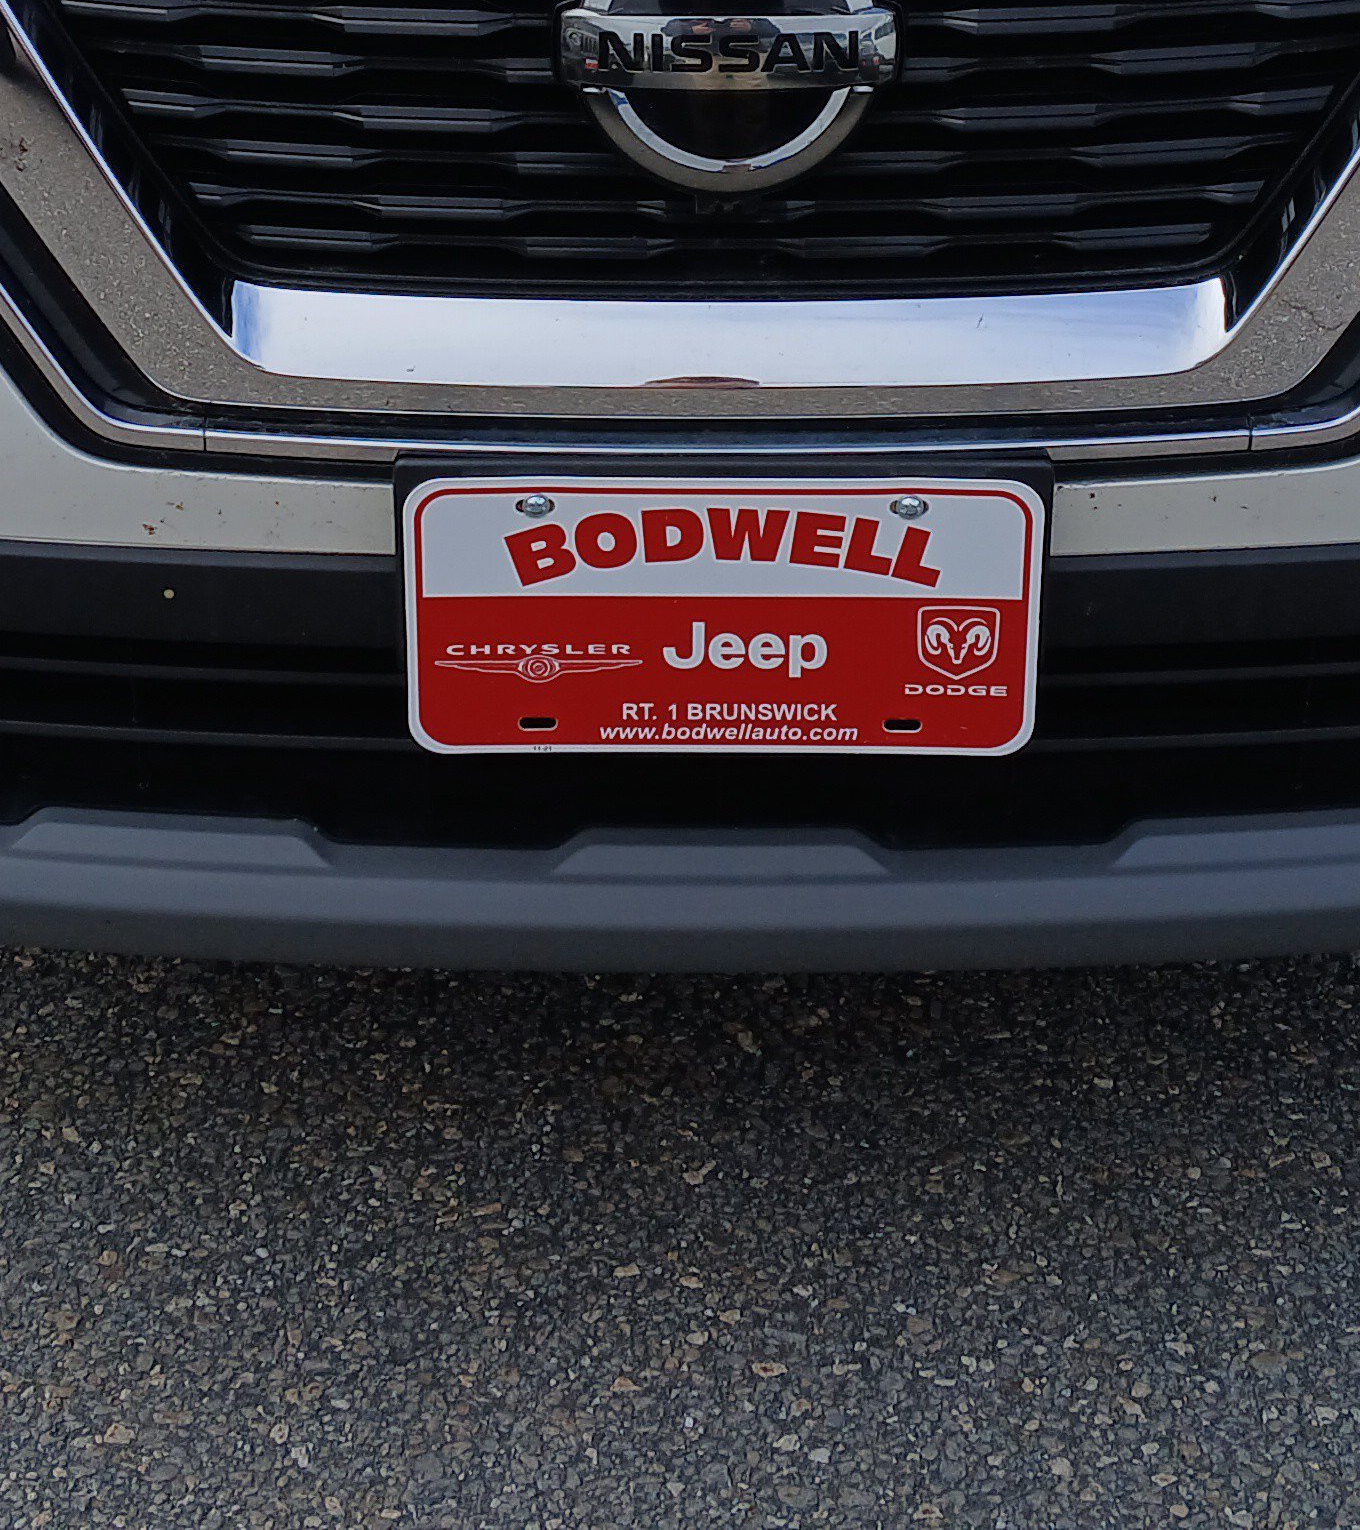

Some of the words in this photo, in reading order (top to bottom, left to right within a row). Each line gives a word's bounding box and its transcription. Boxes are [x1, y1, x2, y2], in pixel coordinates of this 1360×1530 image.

[597, 30, 860, 74] NISSAN
[502, 506, 943, 589] BODWELL
[446, 642, 632, 657] CHRYSLER
[662, 621, 829, 678] Jeep
[904, 683, 1009, 697] DODGE
[621, 702, 660, 722] RT.
[668, 702, 678, 722] 1
[687, 702, 838, 722] BRUNSWICK
[598, 722, 859, 742] www.bodwellauto.com
